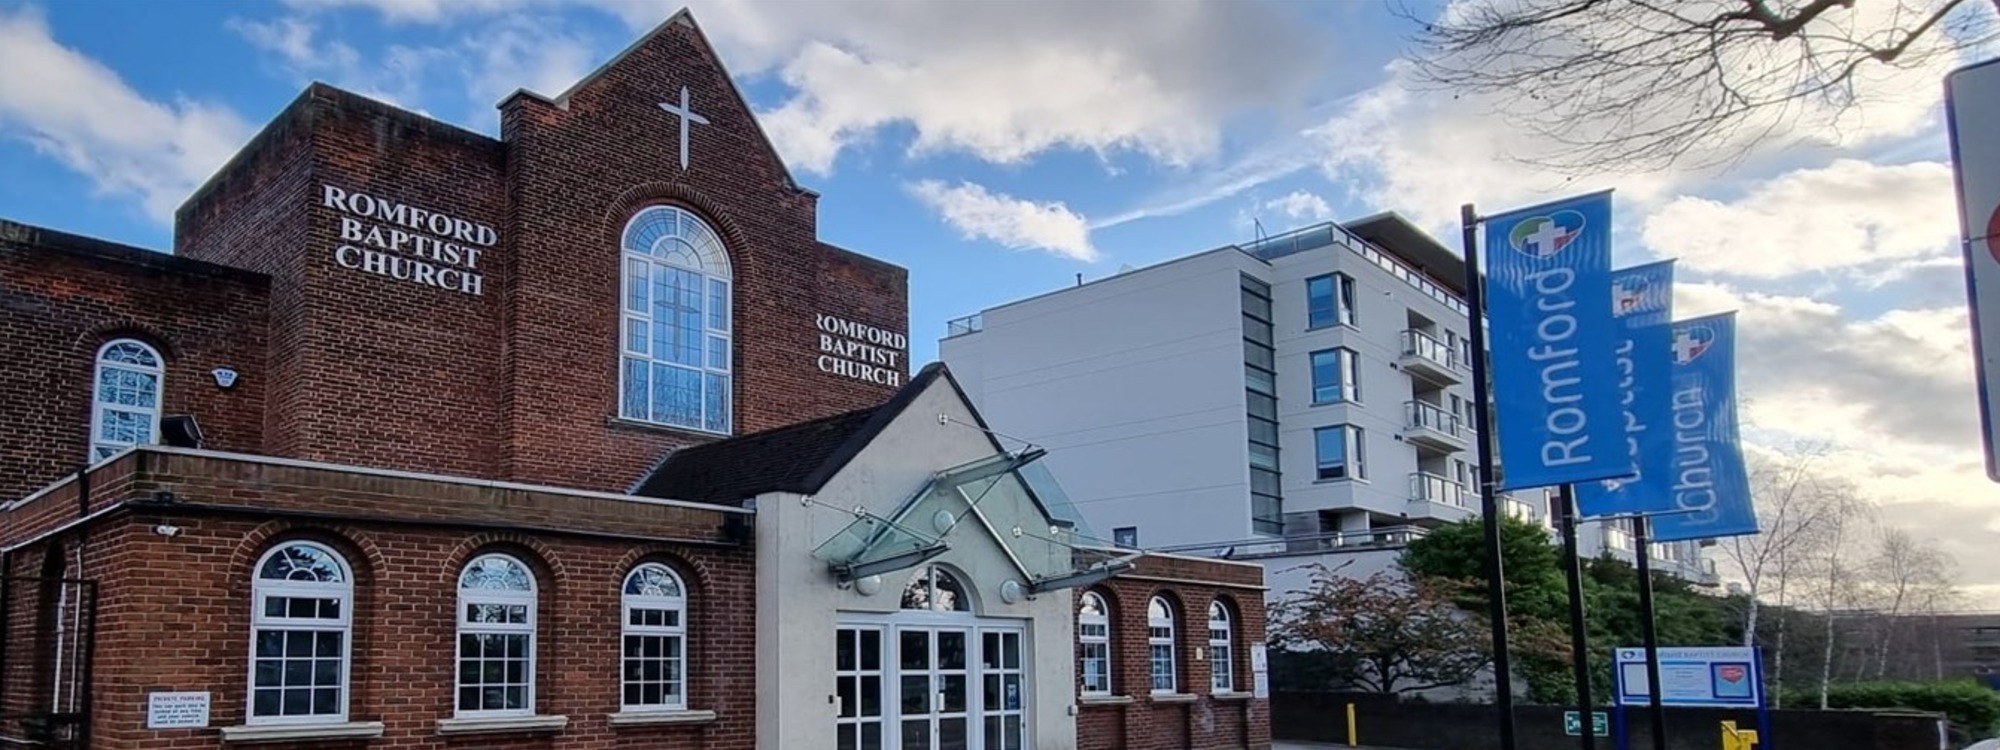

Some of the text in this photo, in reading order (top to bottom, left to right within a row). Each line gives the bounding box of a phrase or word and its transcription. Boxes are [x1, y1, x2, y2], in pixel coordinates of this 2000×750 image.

[322, 184, 498, 247] ROMFORD
[340, 217, 482, 269] BAPTIST
[335, 245, 484, 296] CHURCH
[818, 355, 900, 387] CHURCH
[820, 334, 899, 367] BAPTIST
[1524, 267, 1592, 467] Romford
